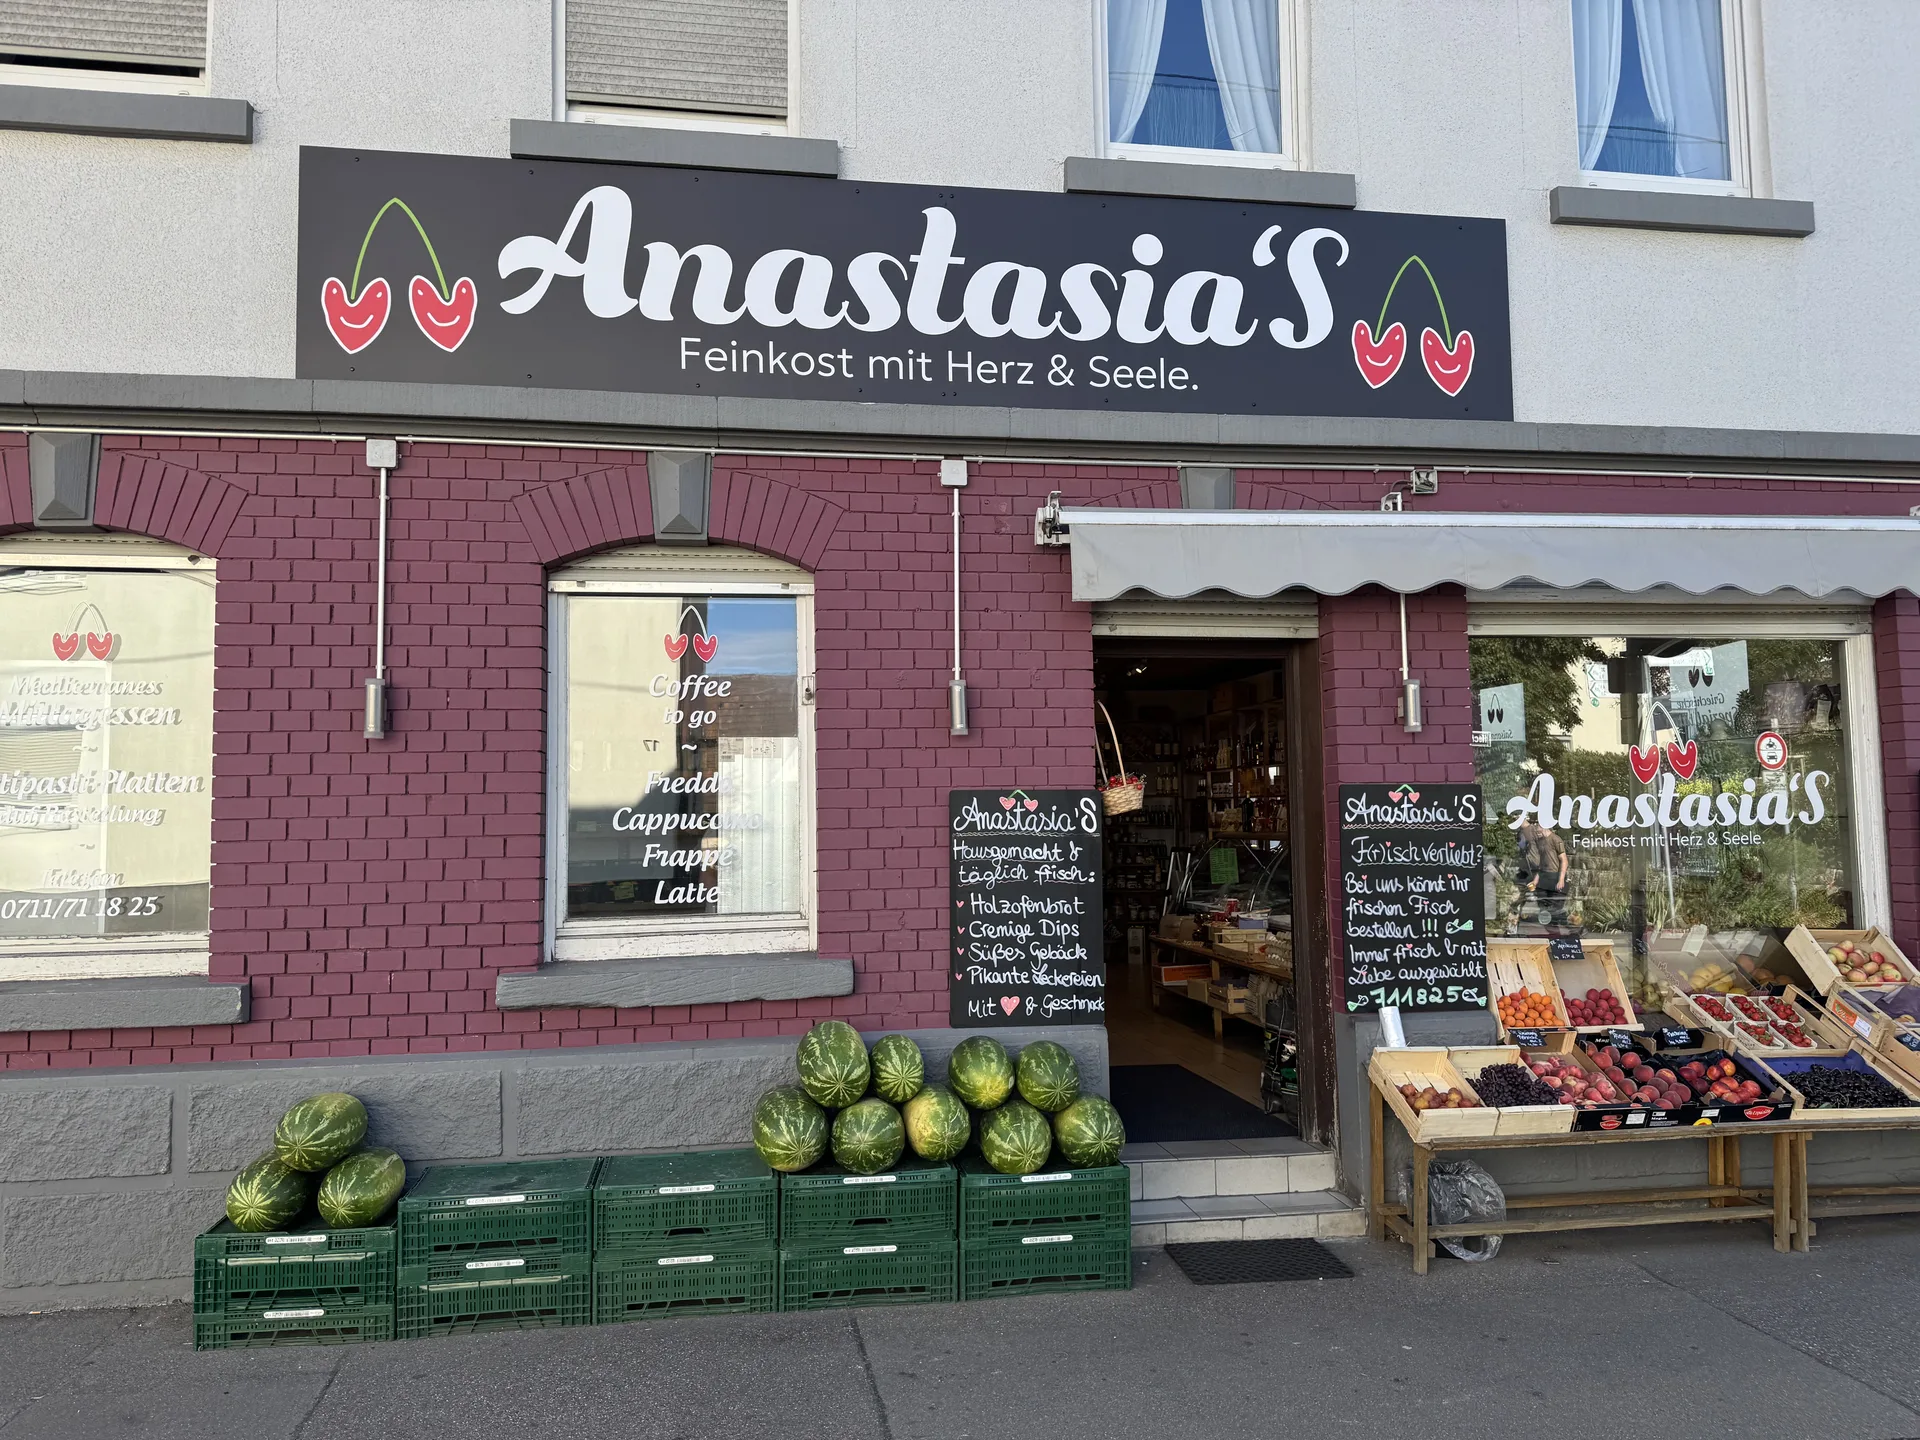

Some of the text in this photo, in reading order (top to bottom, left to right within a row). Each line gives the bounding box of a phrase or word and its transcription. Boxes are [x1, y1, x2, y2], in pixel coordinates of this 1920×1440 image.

[498, 185, 1349, 349] Anastasia'S
[680, 337, 1199, 391] Feinkost mit Herz & Seele.
[649, 674, 731, 701] Coffee
[664, 708, 717, 728] to go
[1506, 770, 1830, 829] Anastasia'S
[953, 797, 1098, 833] Anastasia'S
[953, 839, 1064, 865] Hausgemacht
[1572, 831, 1765, 848] Feinkost mit Herz & Seele.
[643, 843, 734, 872] Frappé
[959, 865, 1028, 889] täglich
[1345, 871, 1471, 894] Bei uns könnt ihr
[654, 880, 721, 905] Latte
[1, 896, 159, 919] 0711/71 18 25
[970, 893, 1086, 919] Holzofenbrot
[1346, 895, 1460, 921] frischen Fisch
[969, 919, 1080, 944] Cremige Dips
[1347, 922, 1419, 939] bestellen
[968, 942, 1088, 971] Süßes Gebäck
[1350, 944, 1391, 964] Immer
[1393, 942, 1441, 964] frisch
[1461, 940, 1487, 957] mit
[967, 964, 1105, 988] Pikante Leckereien
[1348, 964, 1395, 985] Liebe
[968, 998, 997, 1017] Mit
